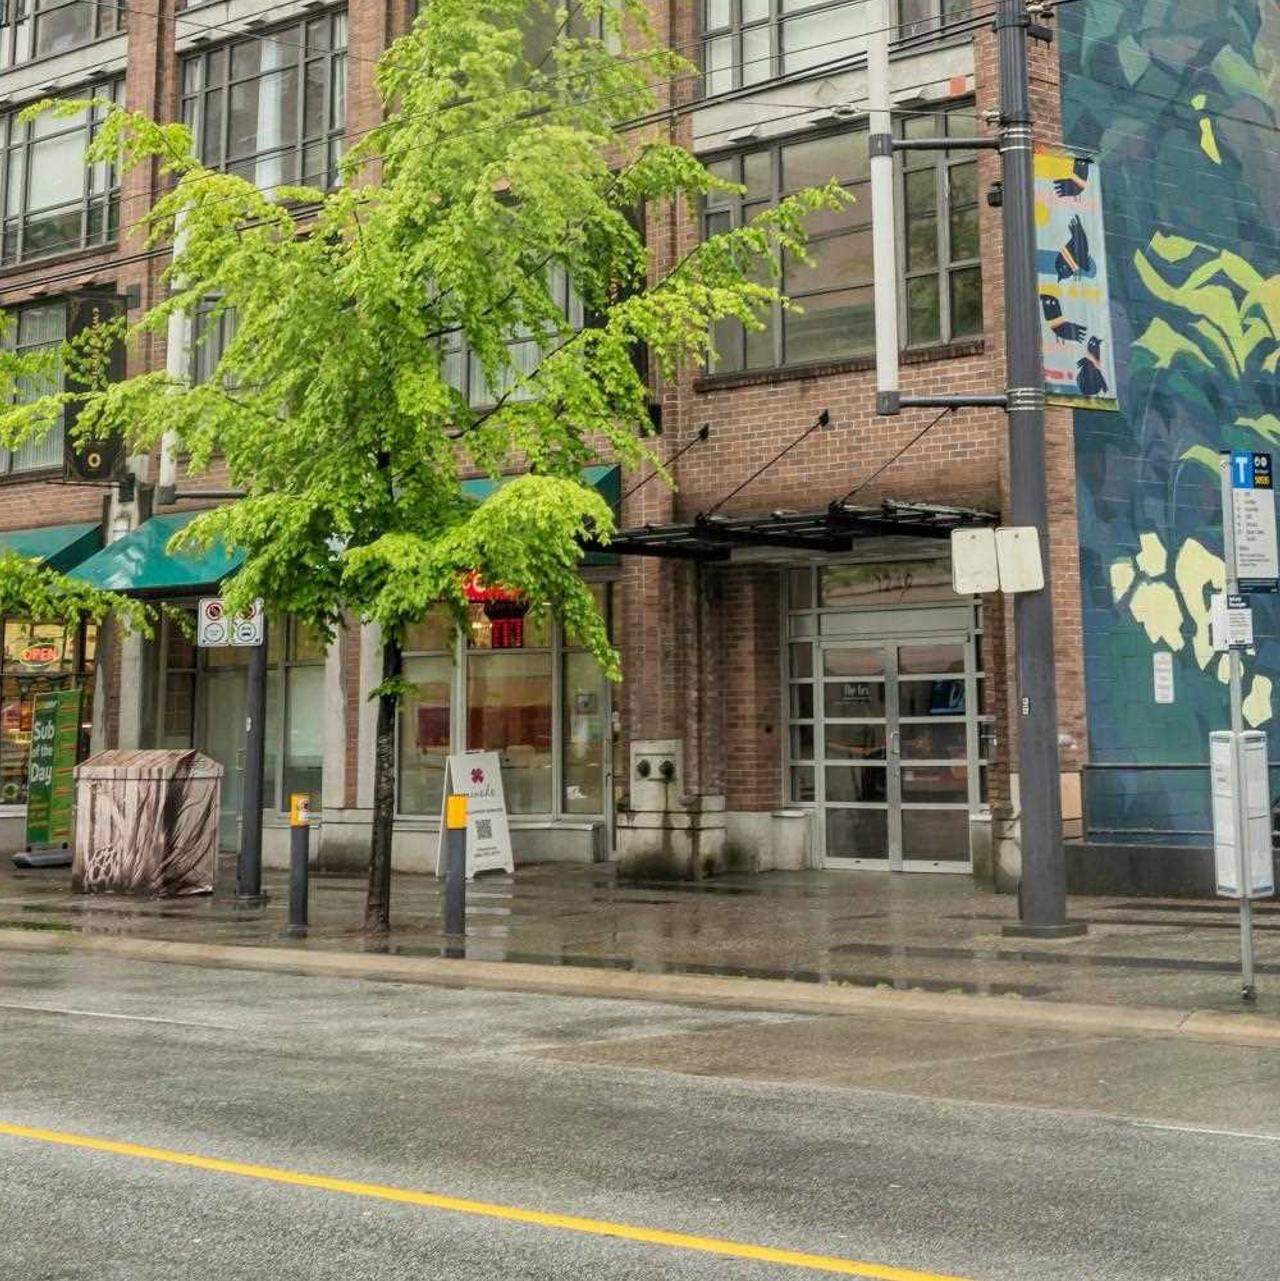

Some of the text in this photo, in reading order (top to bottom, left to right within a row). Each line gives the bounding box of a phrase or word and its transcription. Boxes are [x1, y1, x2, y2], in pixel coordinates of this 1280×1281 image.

[22, 646, 58, 662] OPEN
[33, 720, 55, 740] Sub
[41, 744, 54, 757] the
[30, 763, 53, 786] Day
